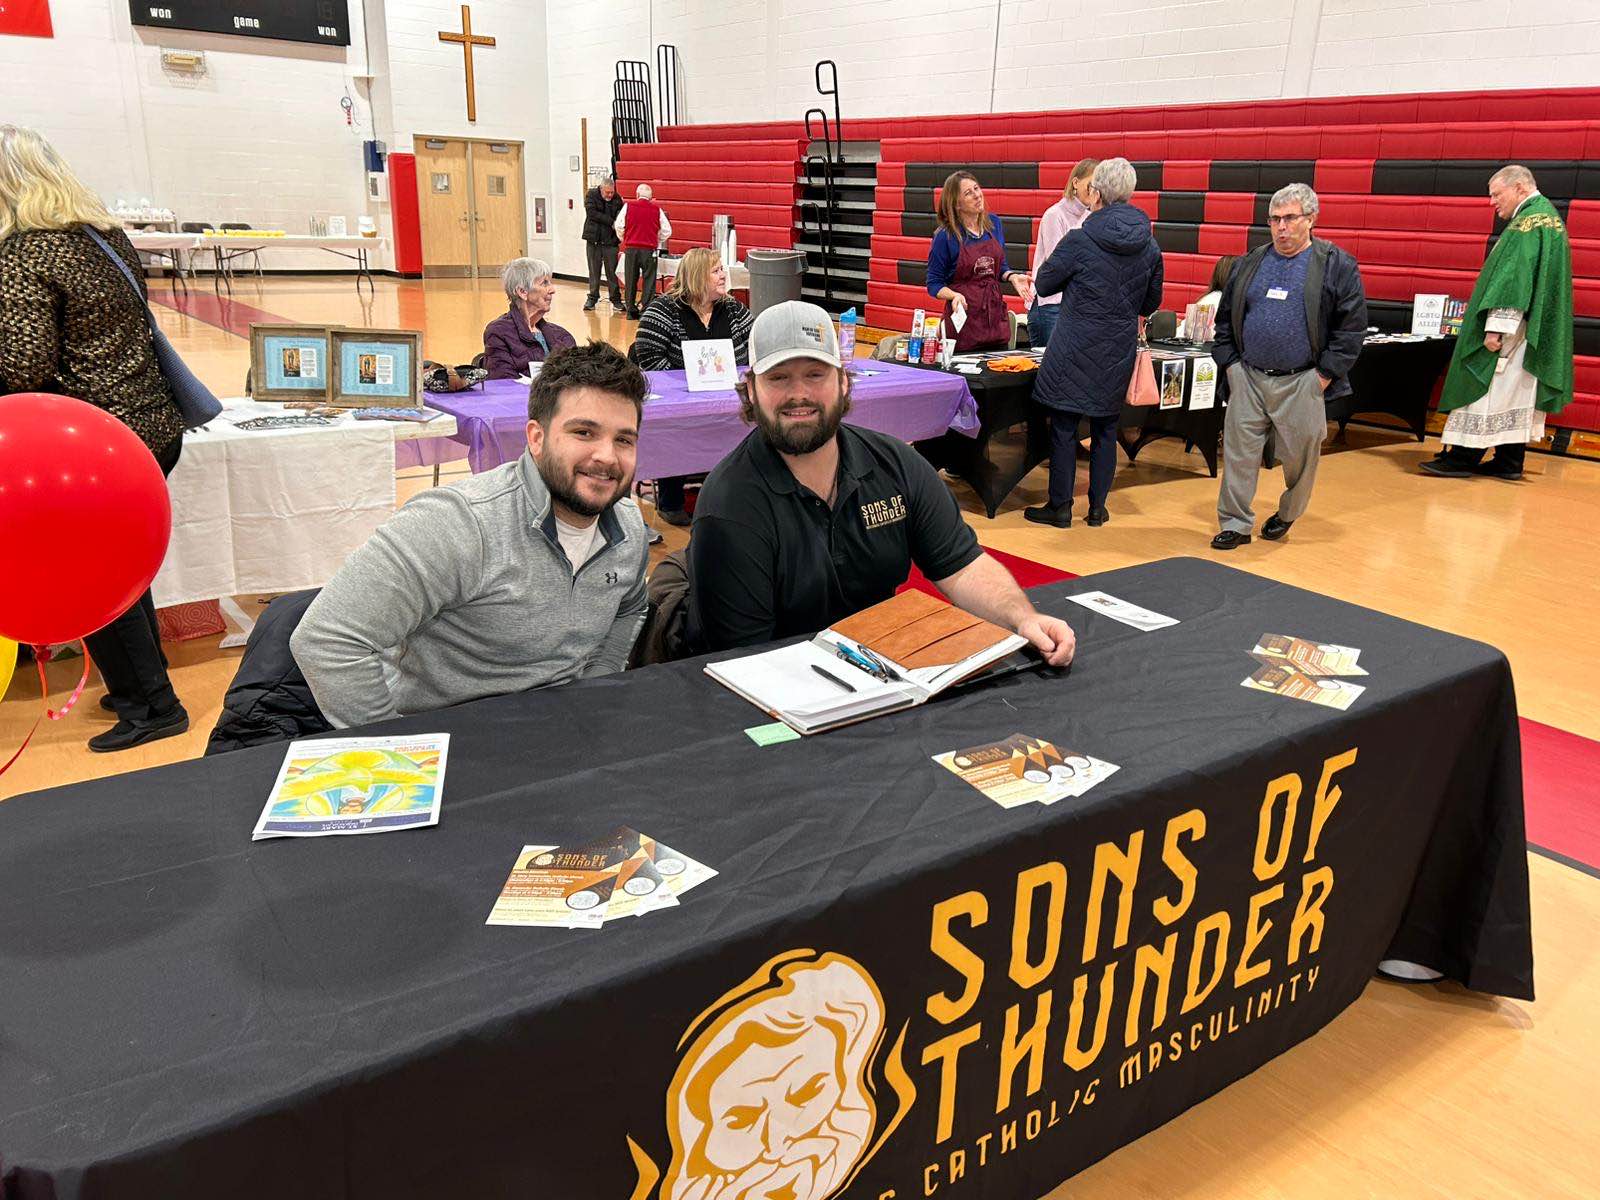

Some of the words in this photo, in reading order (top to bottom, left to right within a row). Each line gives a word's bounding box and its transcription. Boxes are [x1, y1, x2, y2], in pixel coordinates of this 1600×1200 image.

[150, 7, 172, 19] won
[233, 15, 260, 28] game
[317, 25, 337, 37] won
[861, 500, 888, 516] SONS
[890, 494, 903, 507] OF
[863, 505, 906, 526] THUNDER
[555, 859, 606, 867] THUNDER
[926, 809, 1207, 1025] SONS
[1252, 747, 1359, 882] OF
[921, 866, 1334, 1145] THUNDER
[924, 1079, 1100, 1197] CATHOLIC
[1119, 966, 1320, 1089] MASCULINITY
